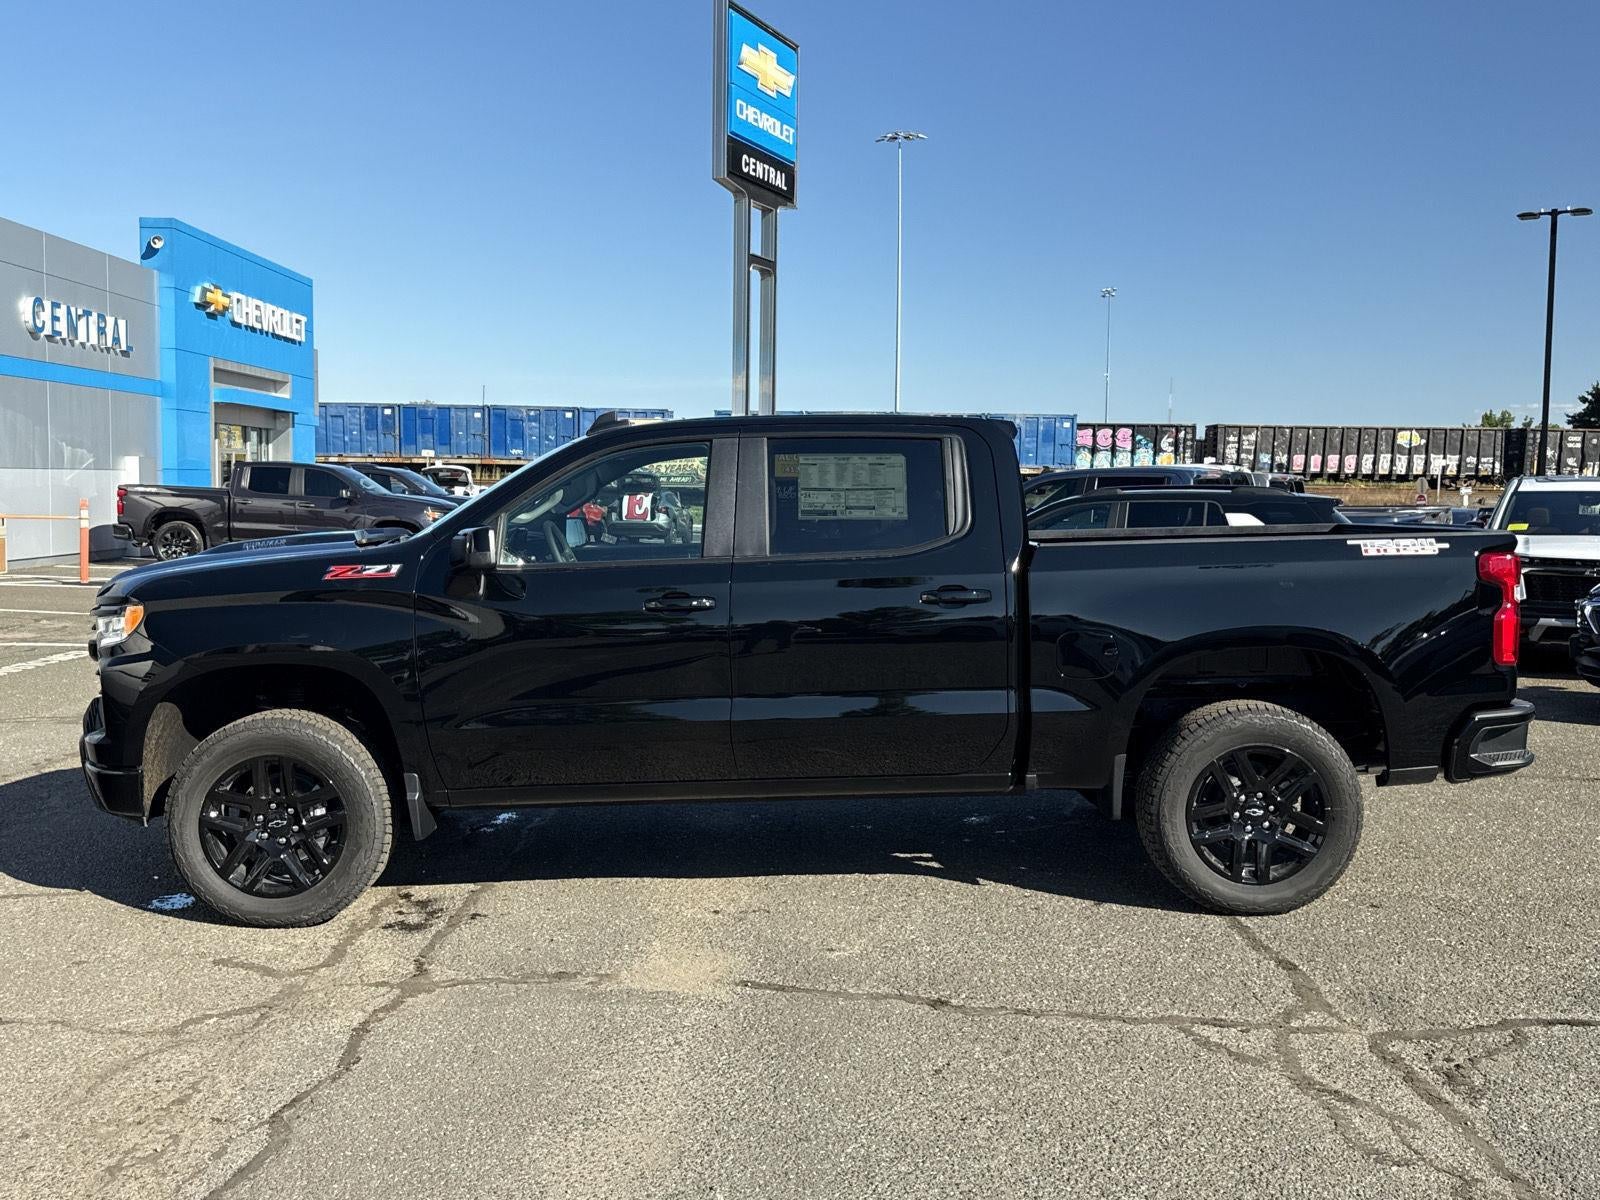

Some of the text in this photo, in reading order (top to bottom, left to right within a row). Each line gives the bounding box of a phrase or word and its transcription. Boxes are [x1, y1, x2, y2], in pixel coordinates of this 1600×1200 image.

[736, 99, 794, 145] CHEVROLET
[741, 154, 787, 190] CENTRAL
[30, 296, 134, 351] CENTRAL
[231, 291, 307, 343] CHEVROLET
[322, 563, 403, 581] Z71
